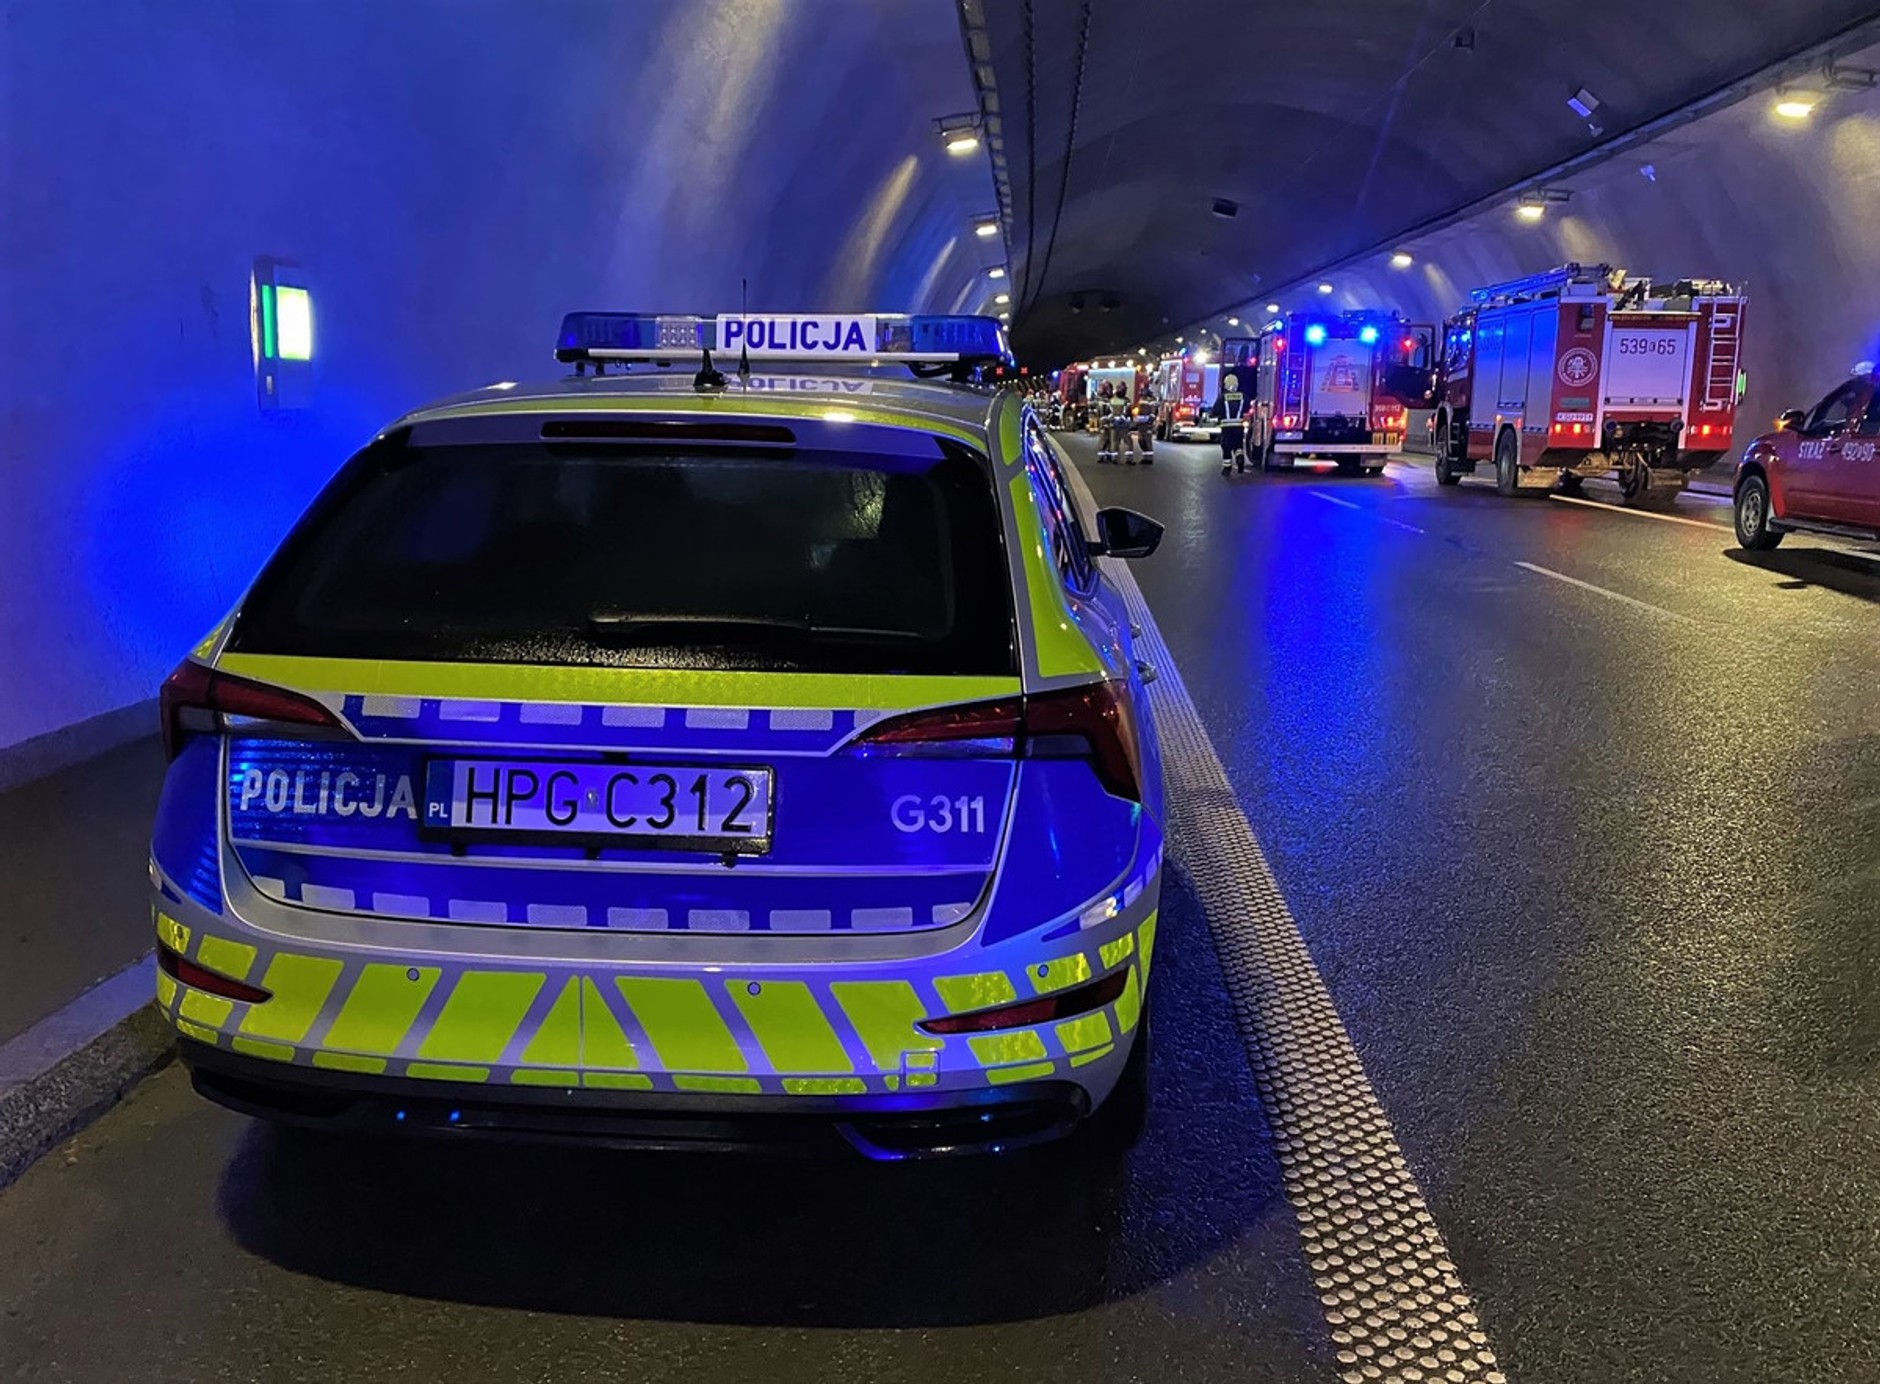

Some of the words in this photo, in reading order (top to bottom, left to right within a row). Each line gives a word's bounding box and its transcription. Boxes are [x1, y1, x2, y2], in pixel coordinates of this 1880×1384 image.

[724, 320, 867, 351] POLICJA
[239, 768, 418, 820] POLICJA
[428, 802, 448, 818] PL
[465, 767, 580, 826] HPG
[605, 773, 752, 833] C312
[890, 794, 984, 833] G311
